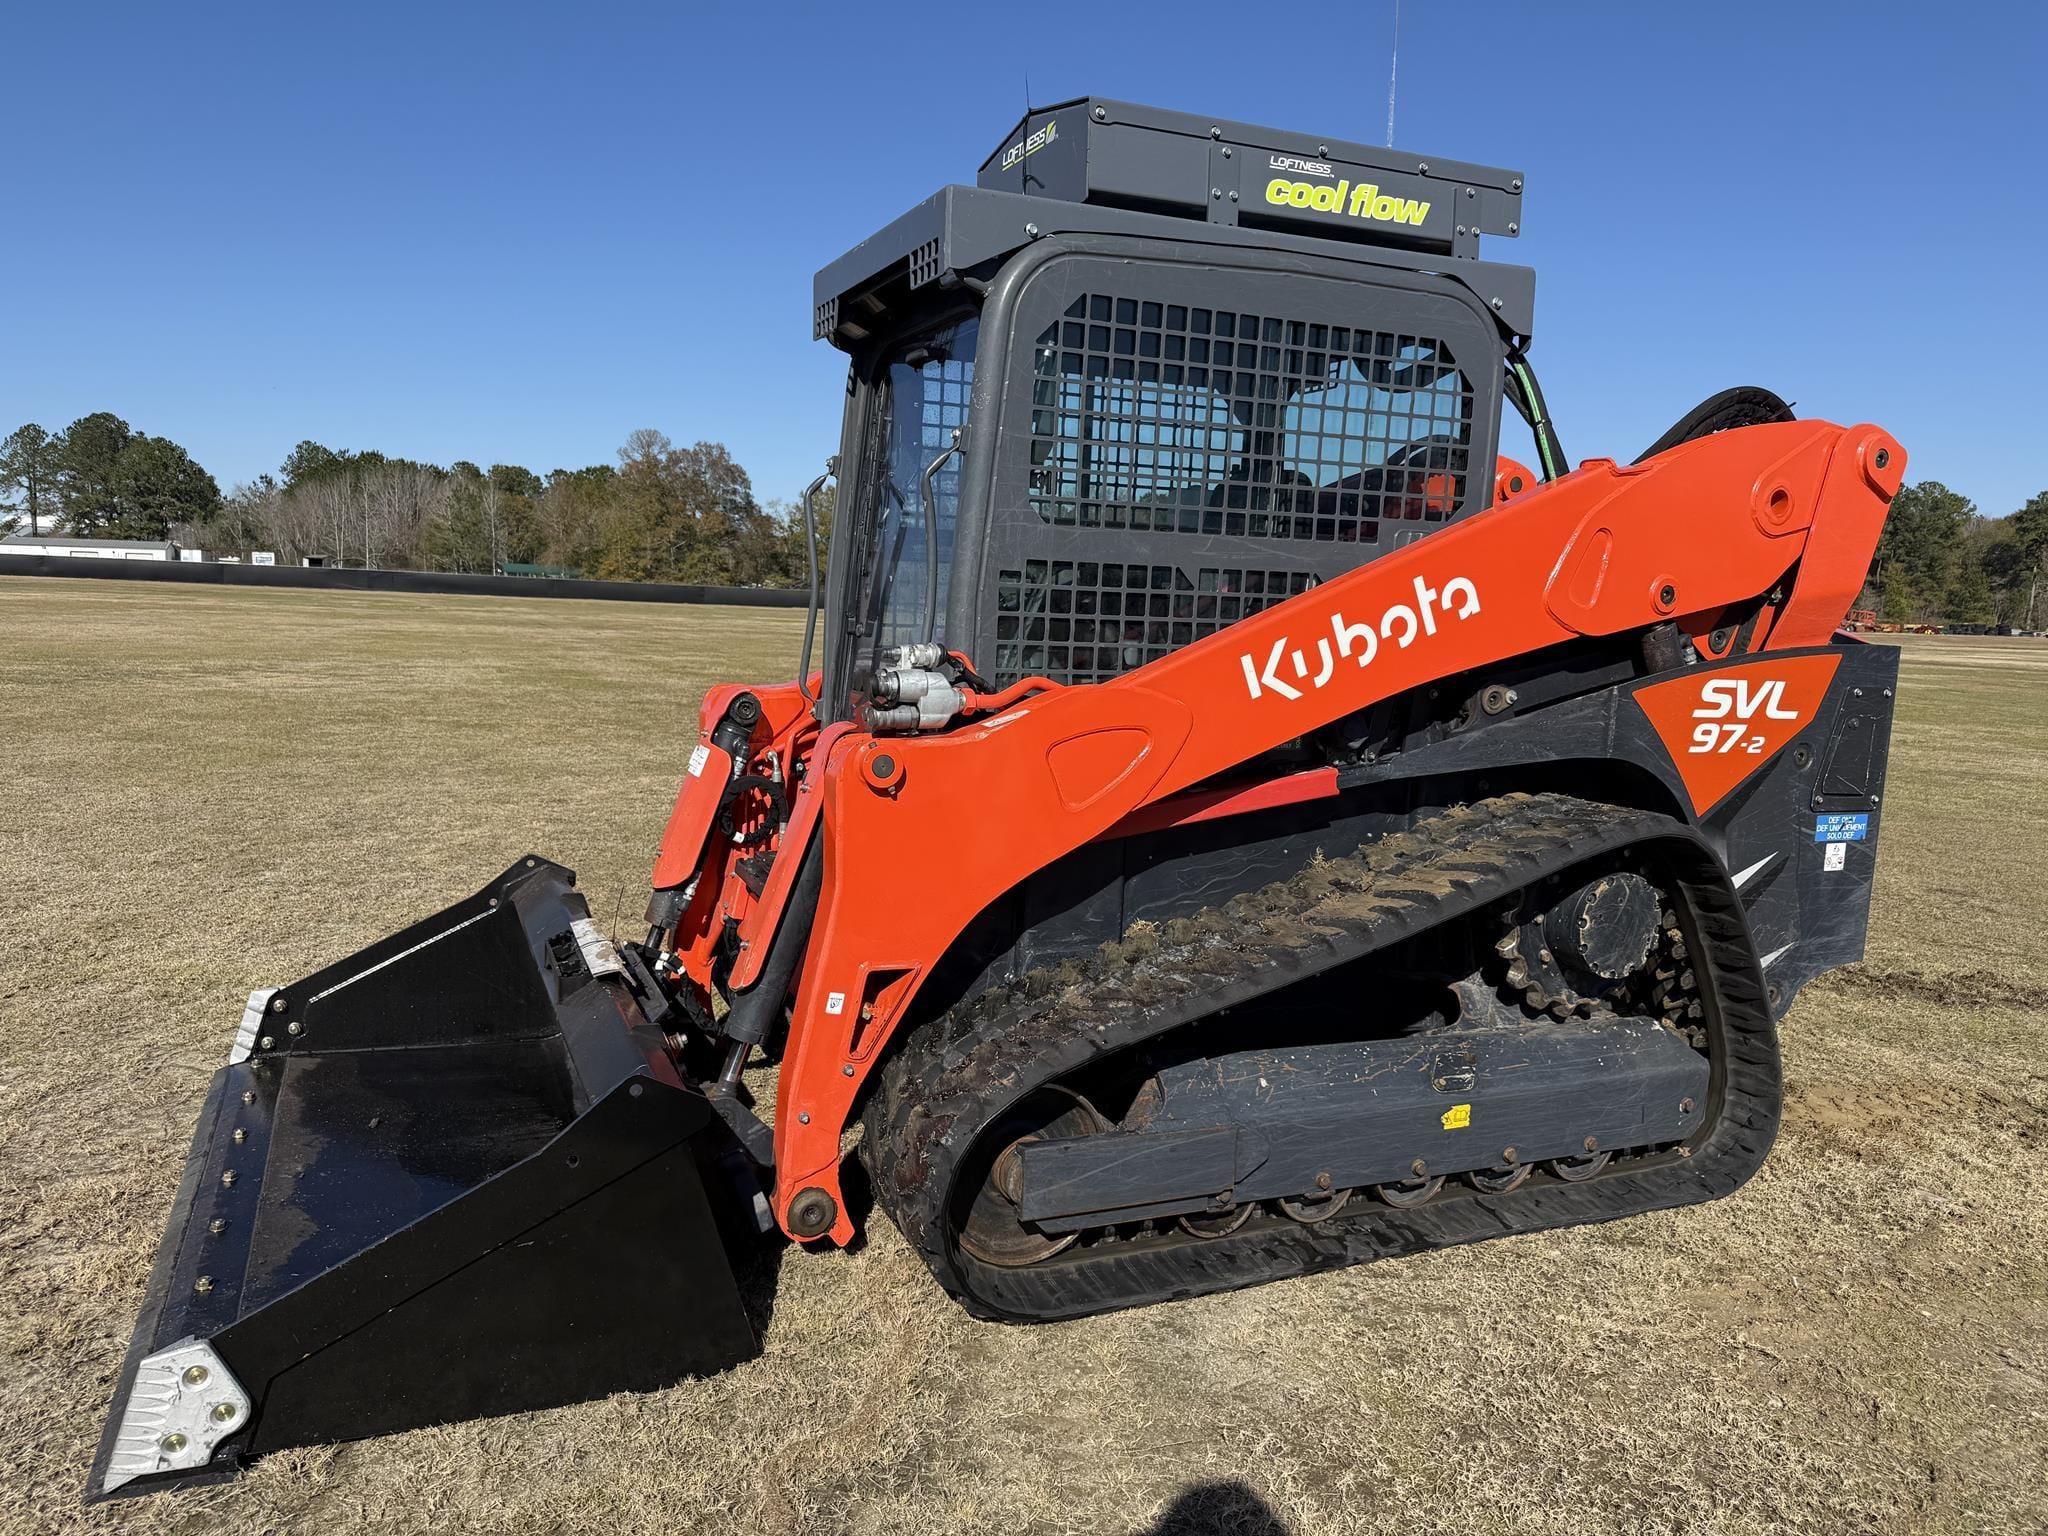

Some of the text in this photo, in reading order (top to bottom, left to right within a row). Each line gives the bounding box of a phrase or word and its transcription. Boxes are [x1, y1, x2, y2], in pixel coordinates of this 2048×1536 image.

[1269, 155, 1332, 175] LOFTNESS
[1266, 178, 1431, 226] cool flow
[1240, 575, 1481, 701] Kubota
[1692, 678, 1799, 720] SVL
[1687, 722, 1766, 754] 97-2
[1816, 824, 1829, 832] DEF
[1828, 816, 1841, 824] DEF
[1827, 831, 1855, 840] SOLO DEF
